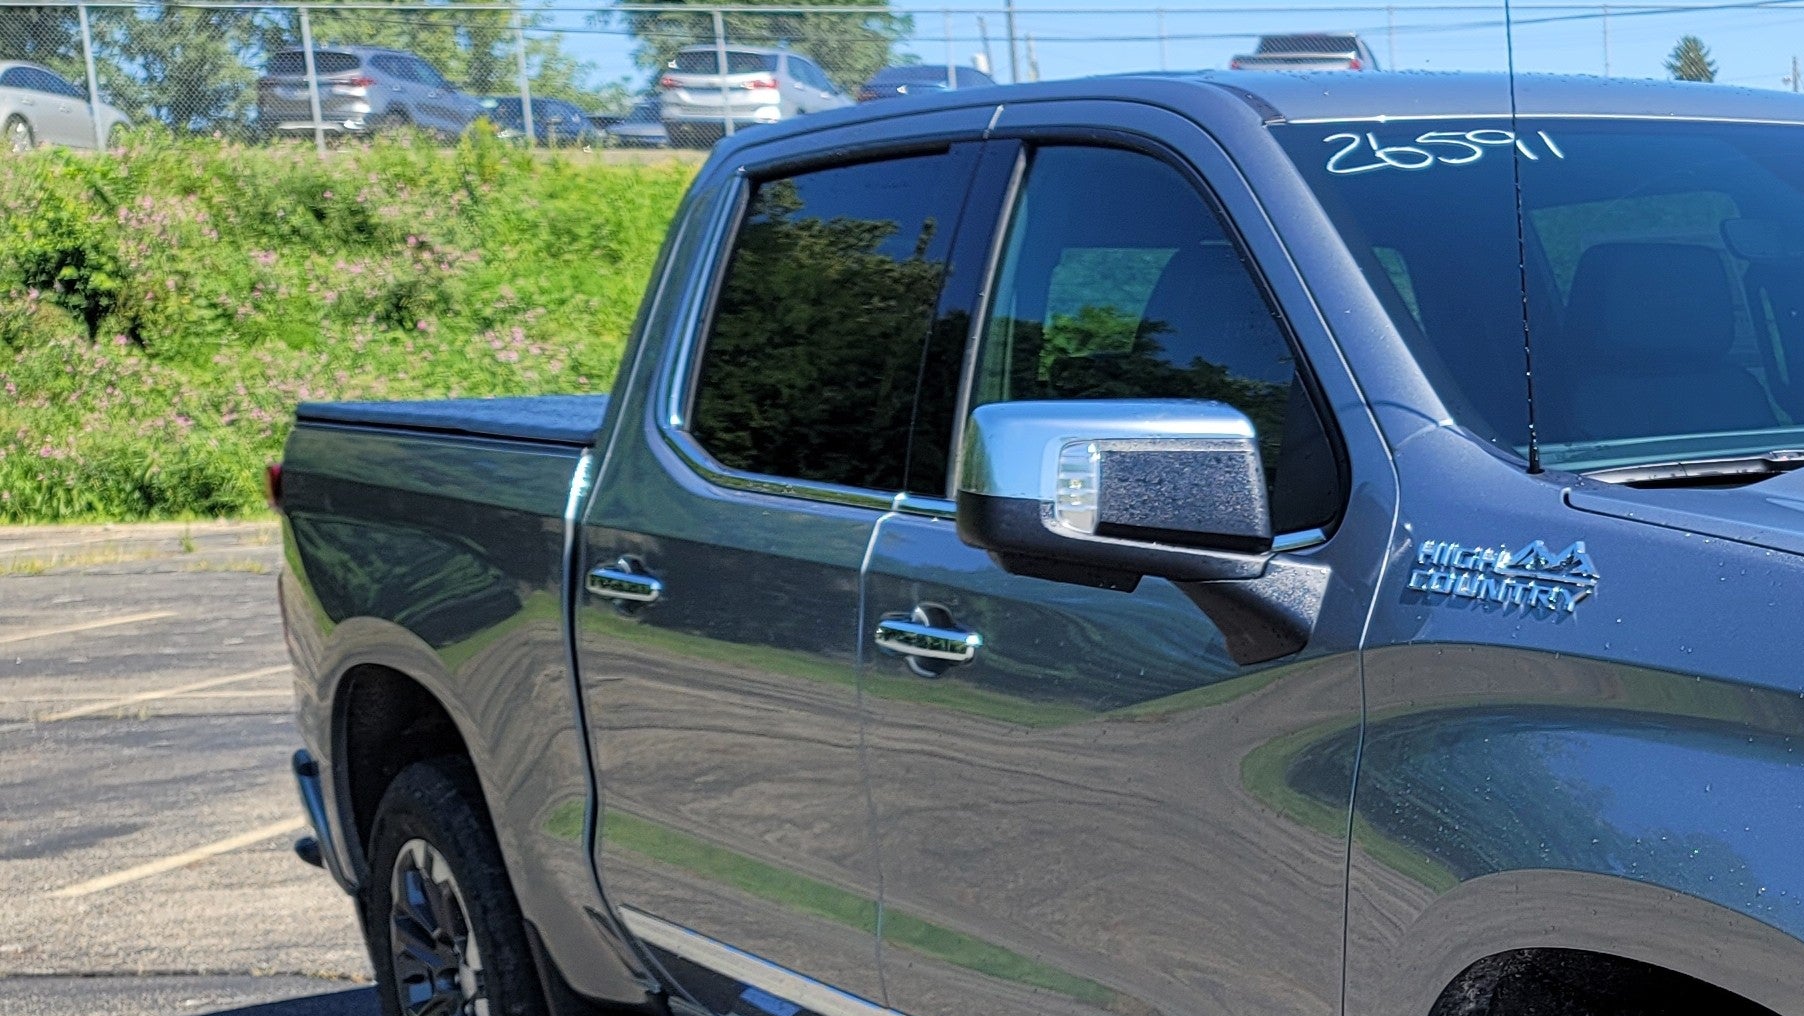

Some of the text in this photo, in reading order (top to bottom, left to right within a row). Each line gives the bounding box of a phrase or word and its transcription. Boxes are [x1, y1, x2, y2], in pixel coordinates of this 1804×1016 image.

[1322, 129, 1565, 175] 26591
[1416, 540, 1508, 574] HIGH
[1406, 567, 1592, 613] COUNTRY
